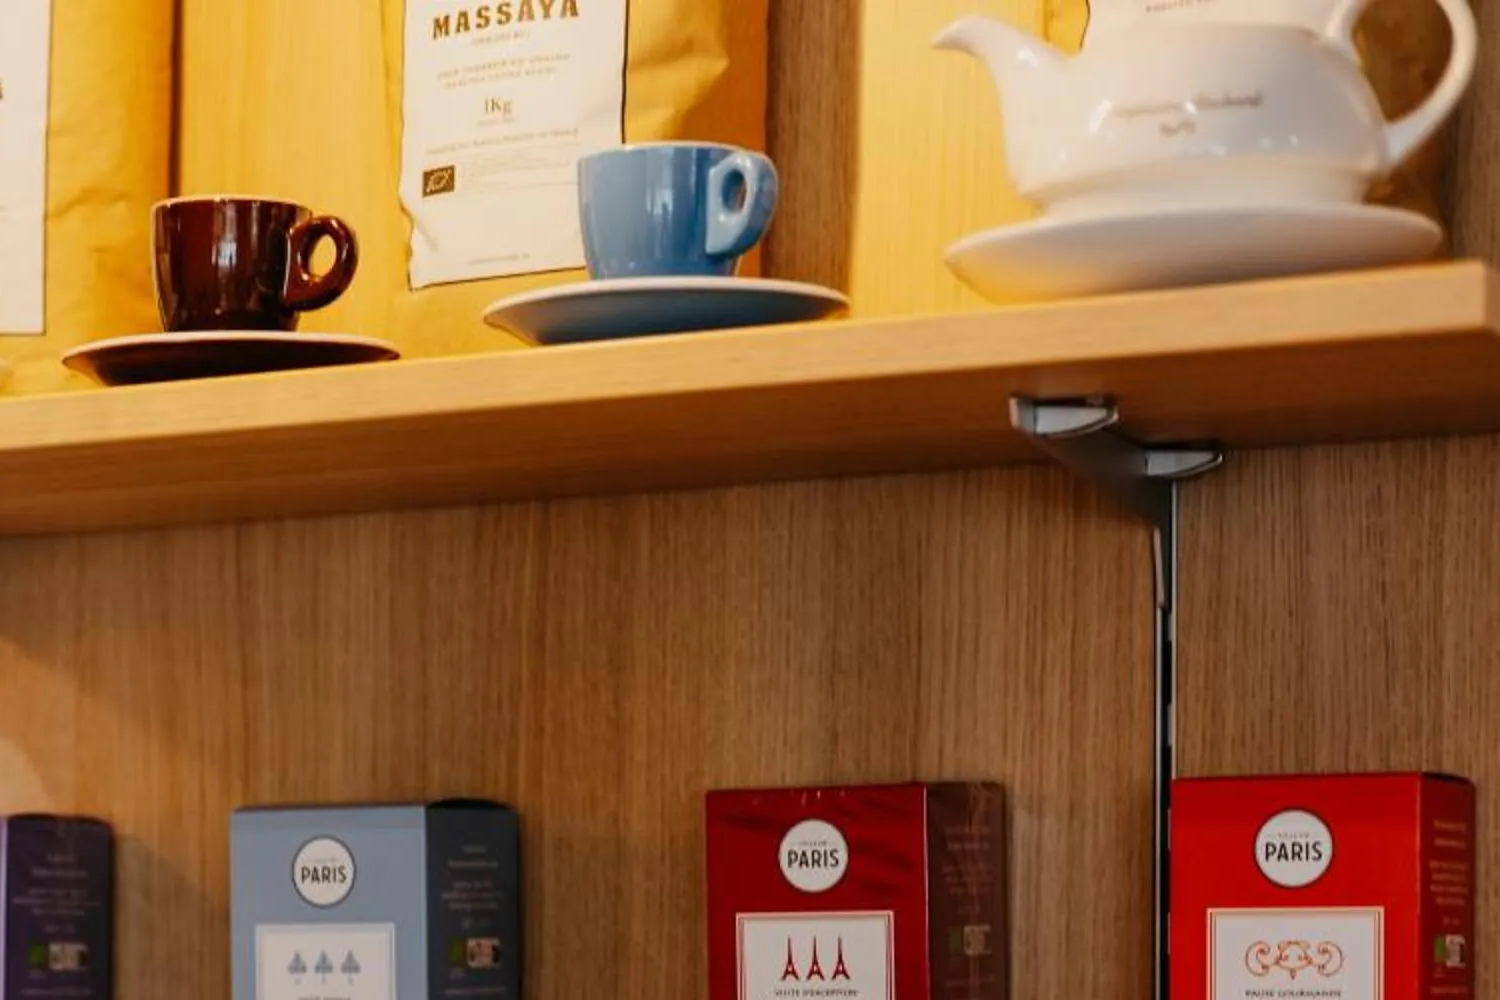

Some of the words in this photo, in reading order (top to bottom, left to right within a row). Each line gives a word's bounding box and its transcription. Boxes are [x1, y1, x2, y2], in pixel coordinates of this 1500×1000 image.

[433, 0, 579, 39] MASSAYA
[787, 848, 840, 869] PARIS
[1265, 841, 1323, 863] PARIS
[301, 865, 347, 885] PARIS
